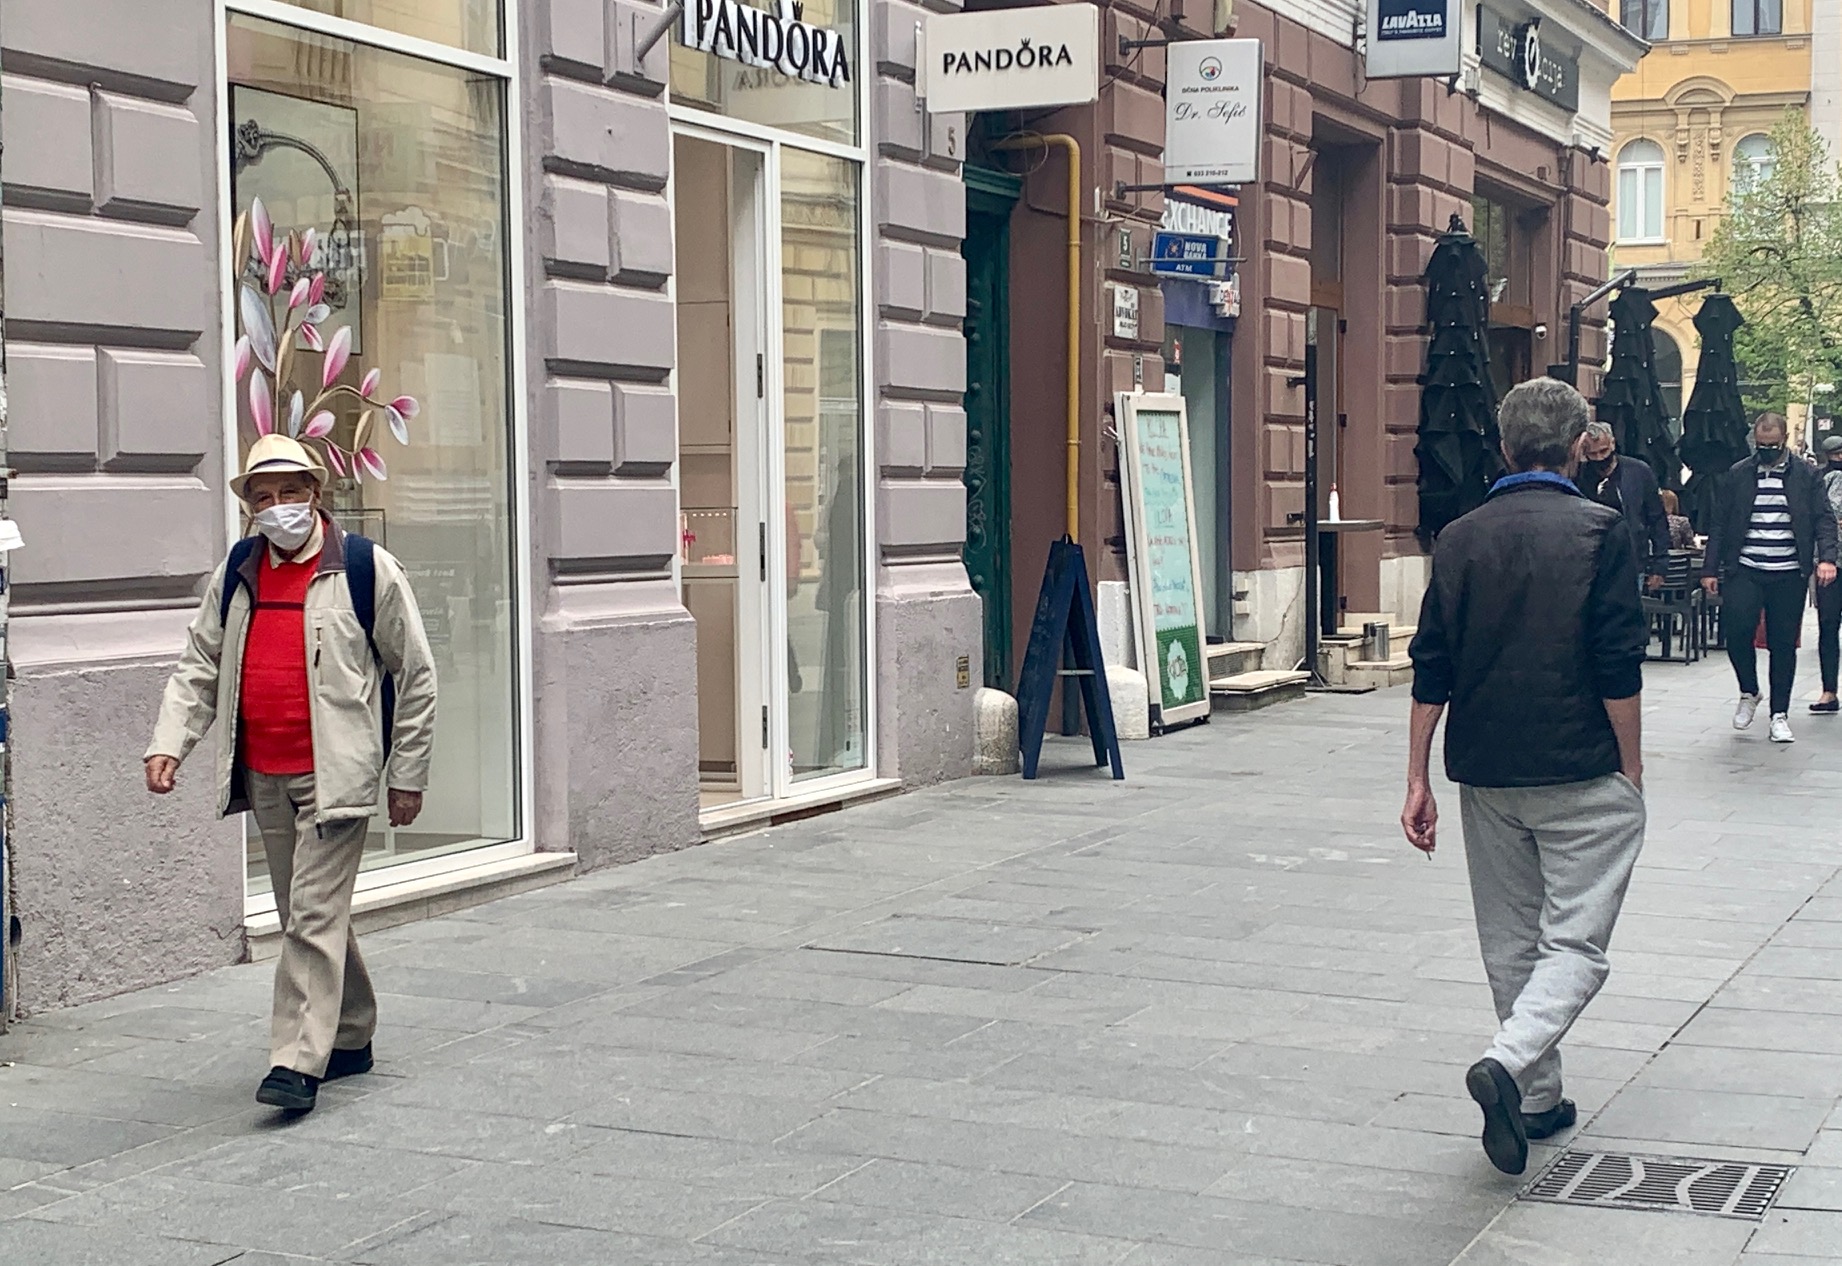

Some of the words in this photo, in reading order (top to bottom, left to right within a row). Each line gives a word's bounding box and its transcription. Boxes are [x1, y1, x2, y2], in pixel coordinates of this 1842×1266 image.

[1382, 10, 1442, 29] LAVAZZA
[695, 0, 850, 84] PANDORA
[943, 41, 1073, 75] PANDORA
[1174, 102, 1201, 121] Dr.
[947, 127, 956, 156] 5
[1122, 237, 1128, 251] 5
[1184, 241, 1207, 252] NOVA
[1175, 263, 1193, 272] ATM
